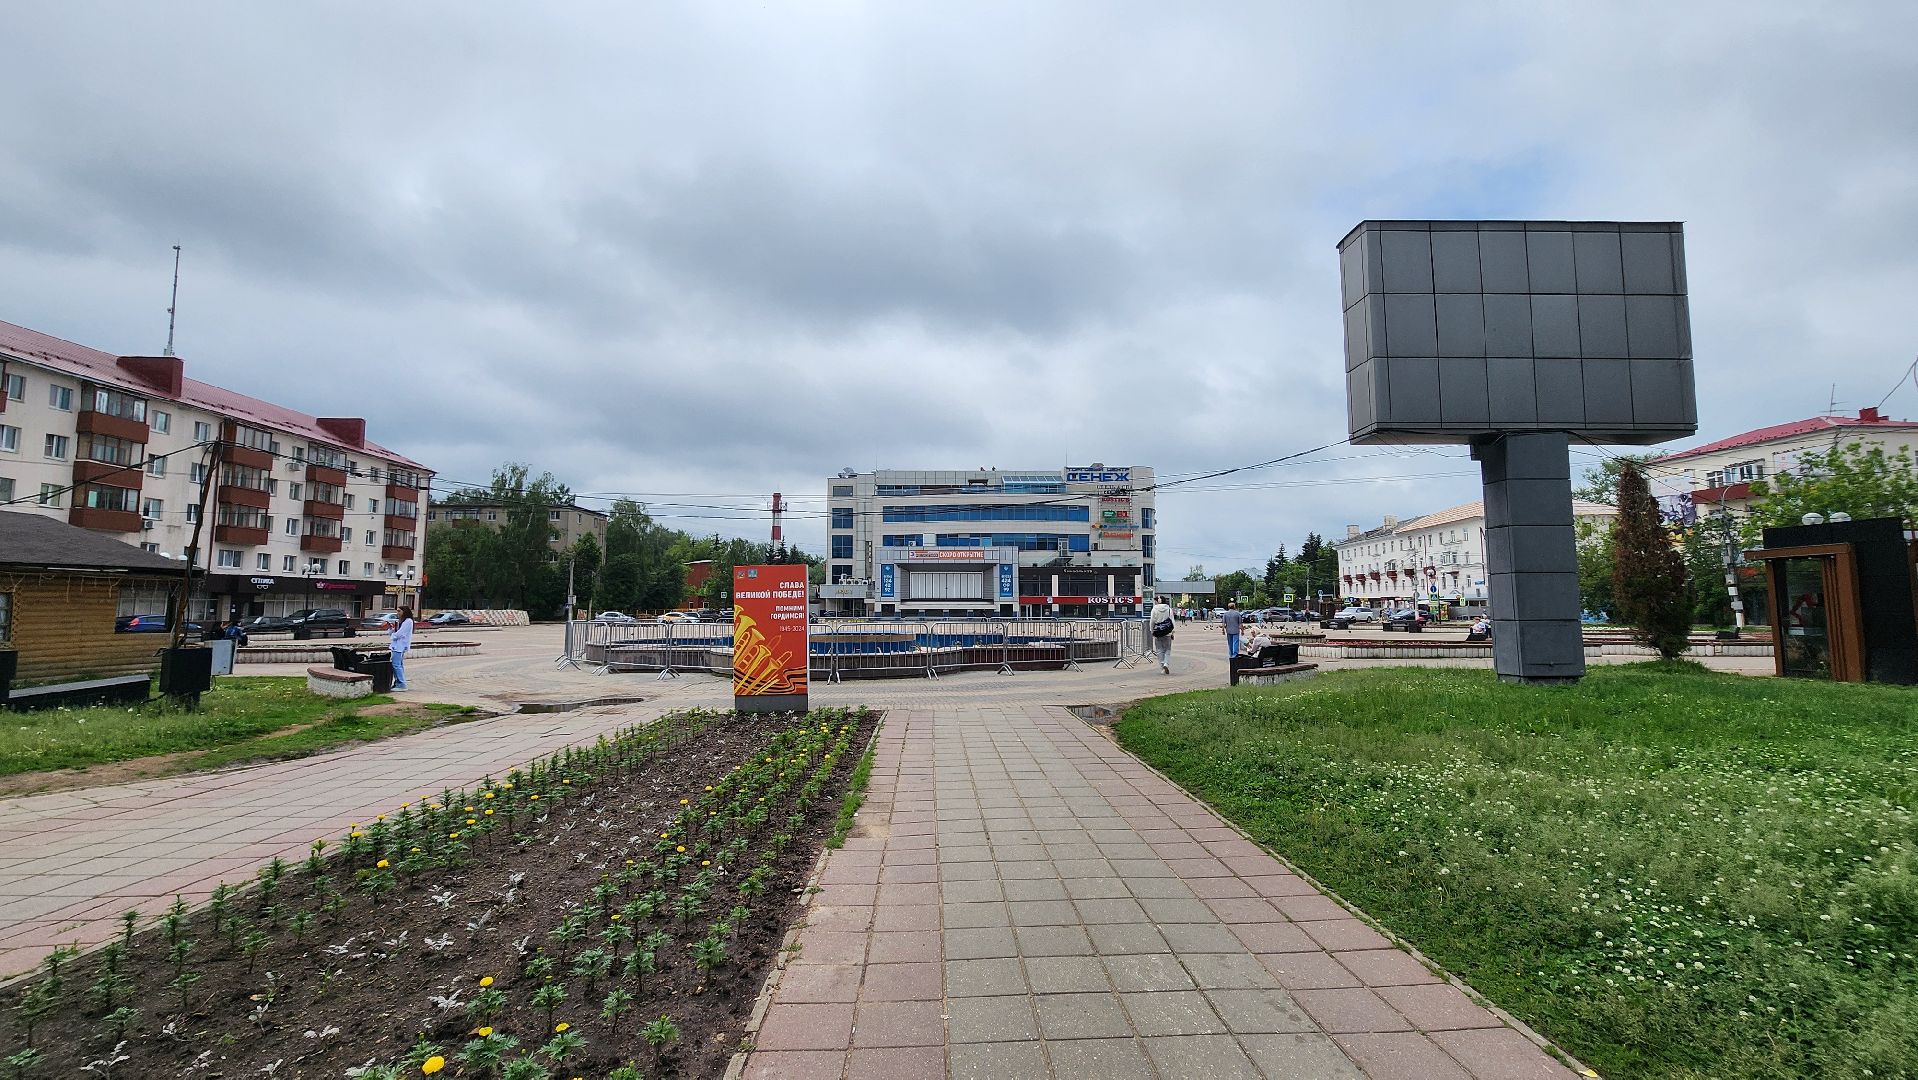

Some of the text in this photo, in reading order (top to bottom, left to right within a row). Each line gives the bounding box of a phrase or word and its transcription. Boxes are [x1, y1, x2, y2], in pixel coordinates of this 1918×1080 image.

[1066, 473, 1129, 481] СЕНЕЖ
[250, 577, 275, 585] ОПТИКА
[779, 581, 805, 589] СЛАВА
[735, 590, 805, 599] ВЕЛИКОЙ ПОБЕДЕ!
[770, 612, 805, 620] ГОРДИМСЯ!
